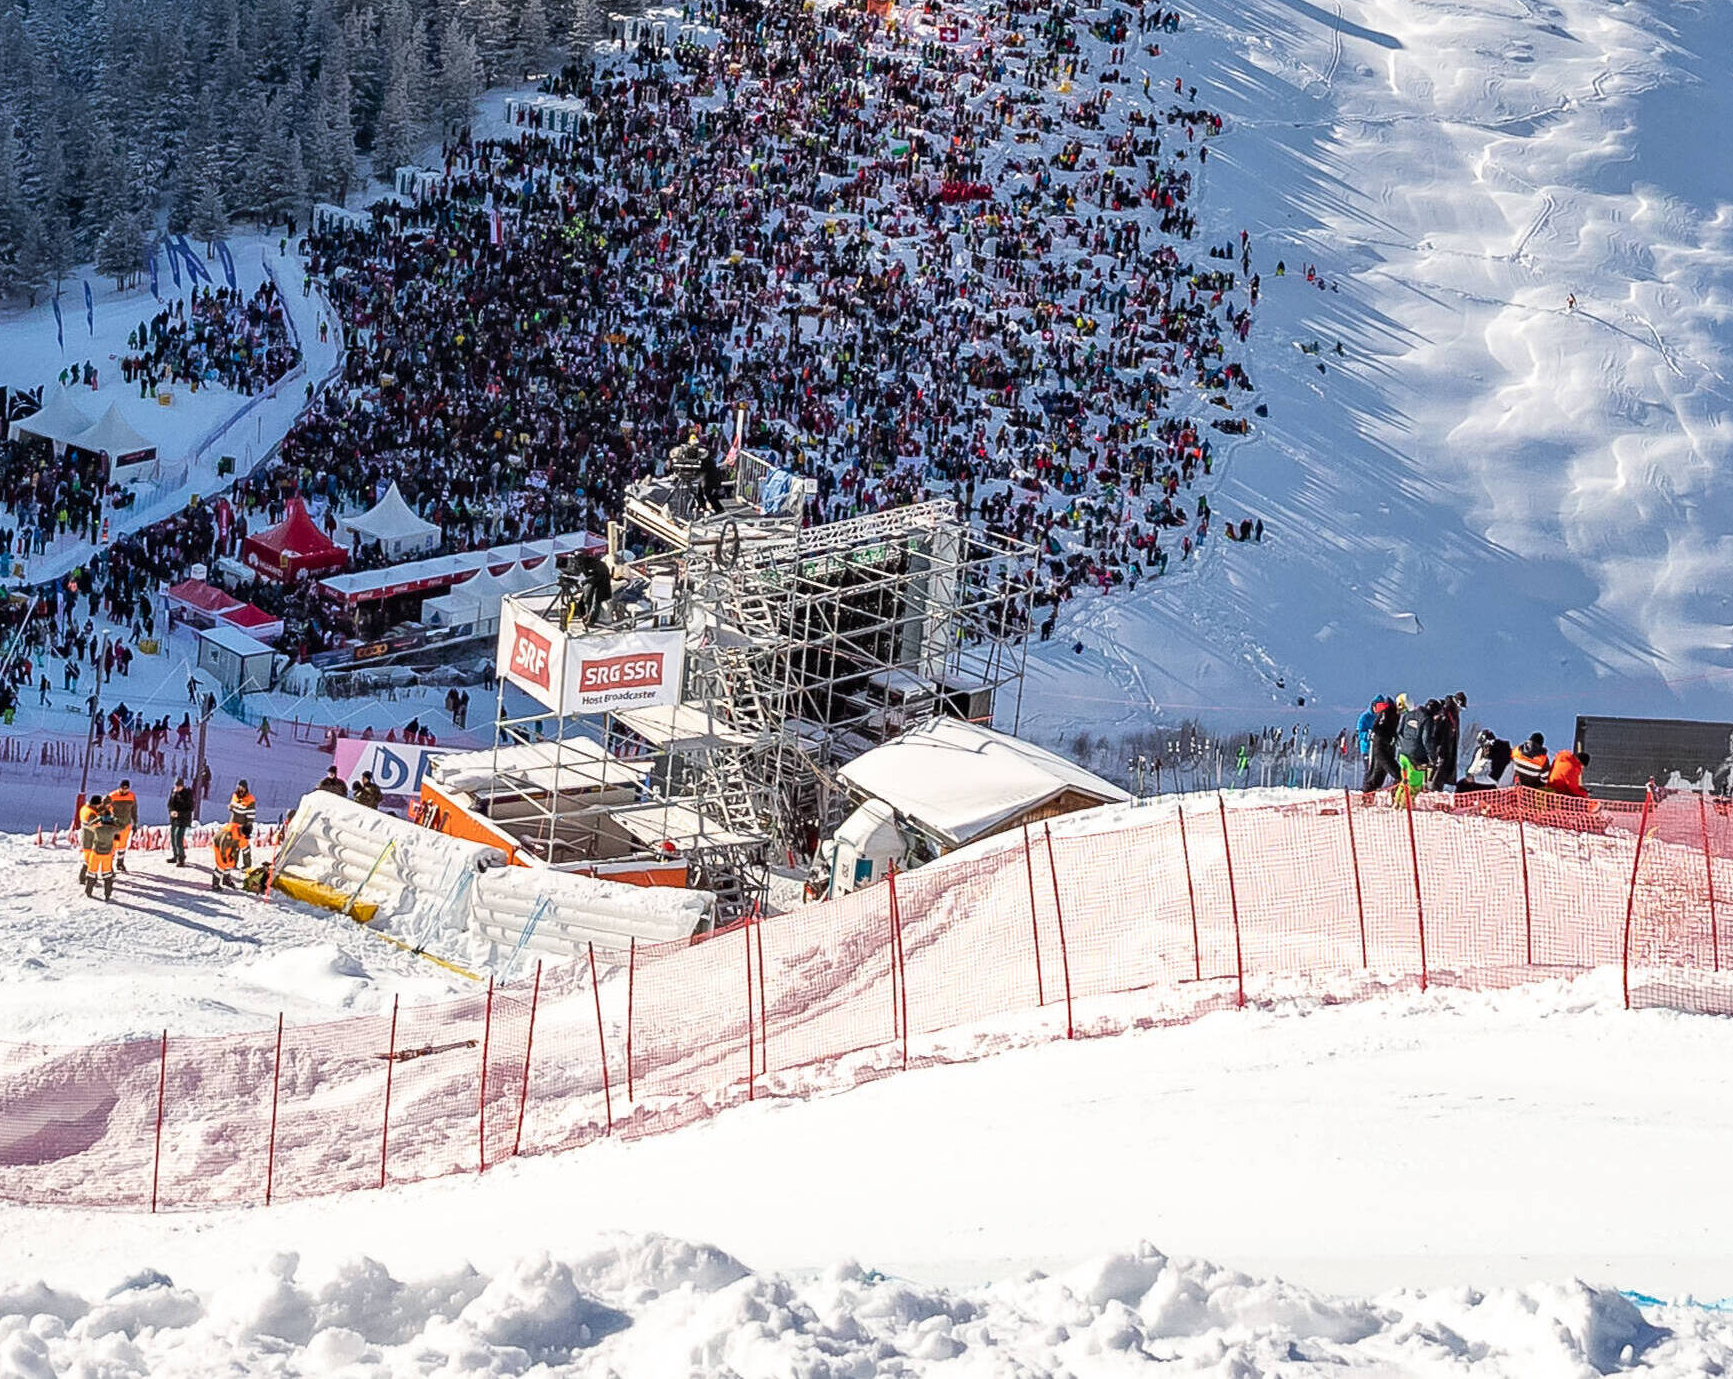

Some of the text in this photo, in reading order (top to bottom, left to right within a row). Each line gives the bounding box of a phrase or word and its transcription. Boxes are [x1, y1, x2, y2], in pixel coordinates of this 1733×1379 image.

[515, 637, 547, 676] SRF
[584, 660, 659, 686] SRG SSR
[582, 690, 656, 706] Host Broadcaster
